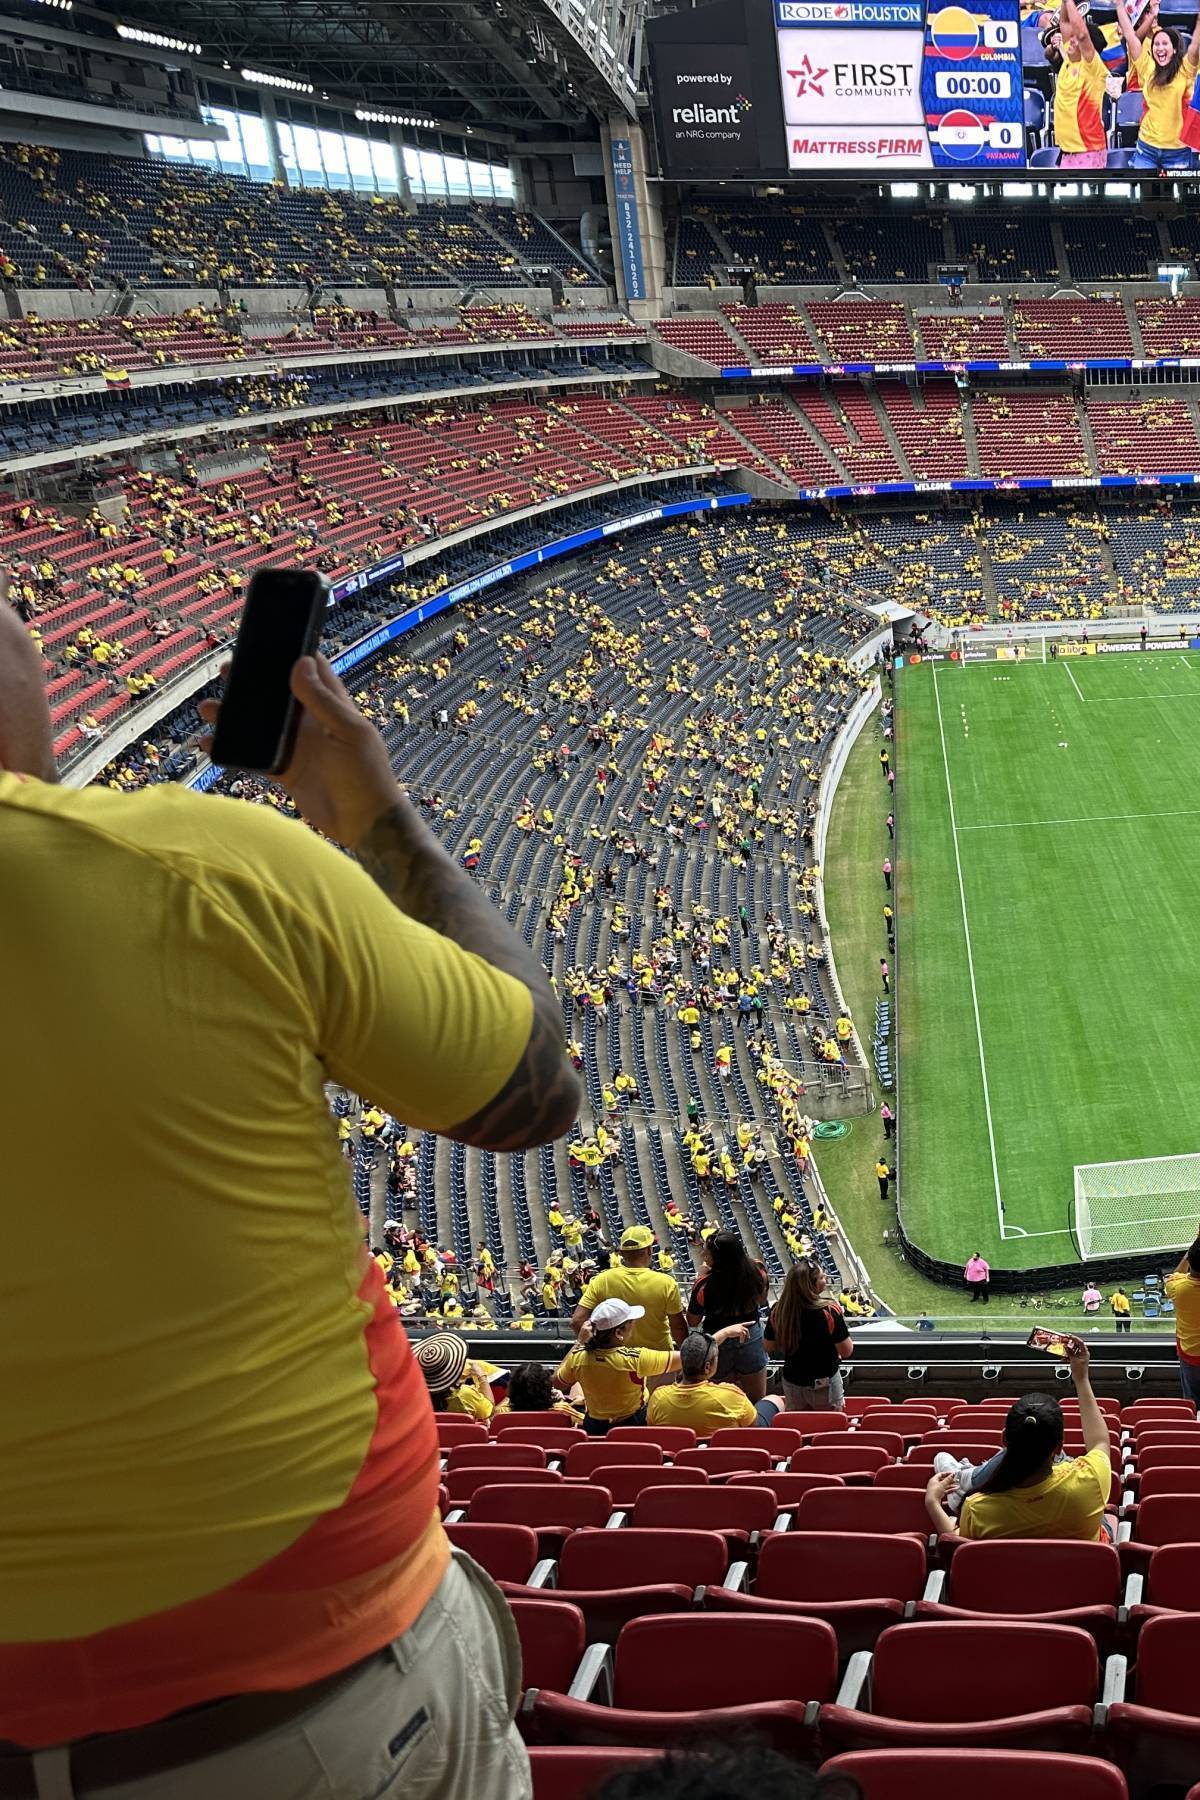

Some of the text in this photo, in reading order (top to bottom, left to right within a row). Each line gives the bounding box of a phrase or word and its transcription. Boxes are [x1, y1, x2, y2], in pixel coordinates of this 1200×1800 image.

[996, 26, 1008, 43] 0
[981, 53, 1016, 61] COLOMBIA
[677, 73, 732, 86] powered by
[834, 63, 913, 87] FIRST
[947, 77, 1001, 95] 00:00
[835, 88, 914, 97] COMMUNITY
[672, 103, 741, 124] reliant
[675, 130, 741, 140] an NRG company
[1000, 127, 1012, 144] 0
[999, 361, 1031, 369] WELCOME
[914, 482, 952, 491] WELCOME
[1146, 640, 1189, 649] POWERADE
